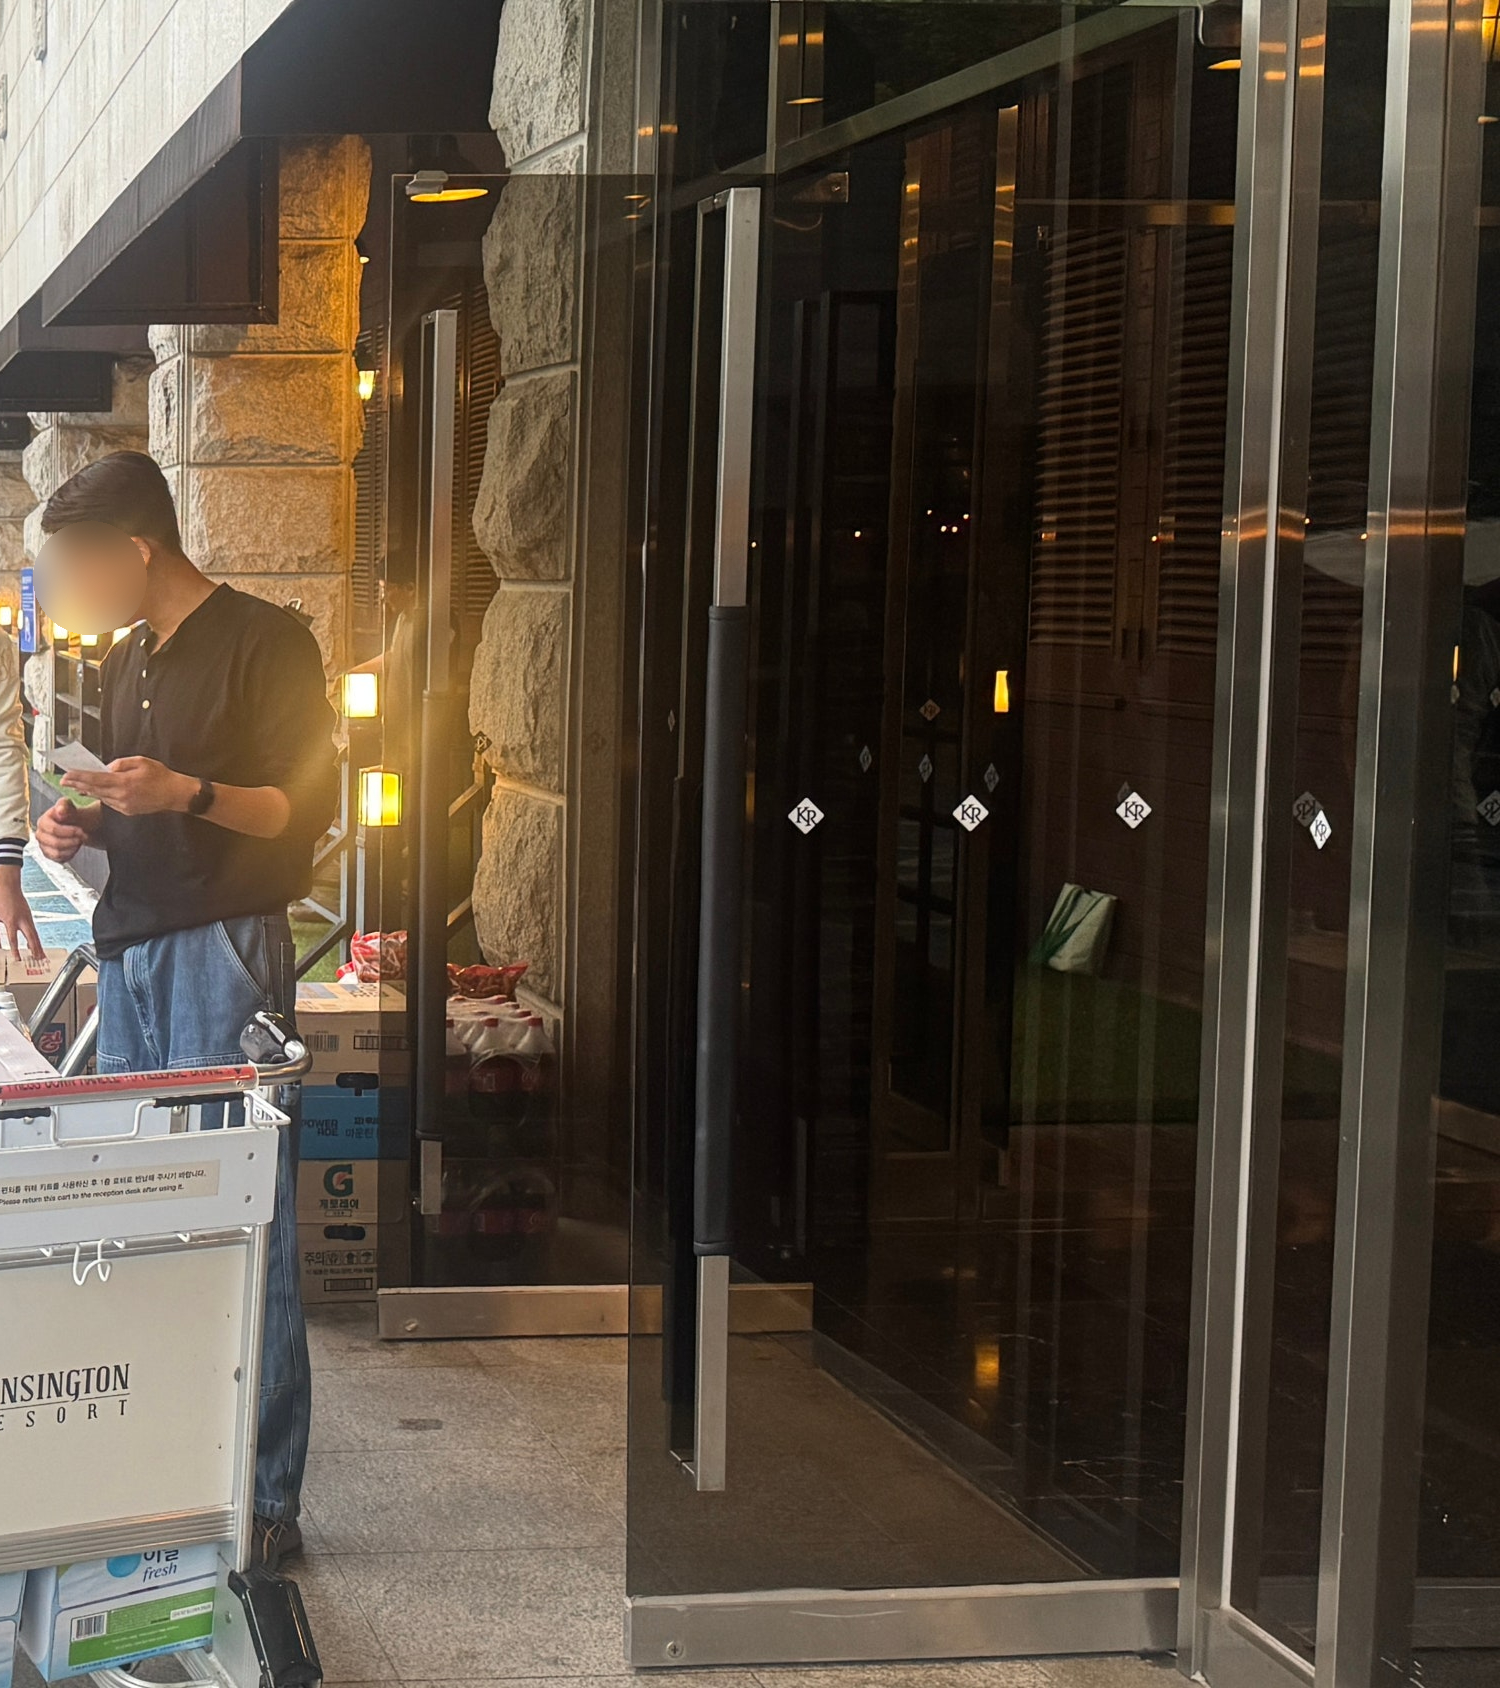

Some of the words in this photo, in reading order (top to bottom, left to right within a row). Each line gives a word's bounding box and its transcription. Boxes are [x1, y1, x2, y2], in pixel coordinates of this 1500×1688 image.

[796, 806, 817, 826] KR
[960, 803, 982, 824] KR
[1124, 801, 1145, 821] KR
[1315, 820, 1327, 841] KR
[324, 1164, 353, 1198] G
[22, 1196, 42, 1204] return
[43, 1194, 55, 1202] this
[57, 1193, 71, 1201] cart
[80, 1191, 91, 1199] the
[93, 1188, 124, 1198] reception
[125, 1187, 141, 1195] desk
[142, 1186, 158, 1194] after
[159, 1184, 176, 1193] using
[319, 1198, 359, 1210] 게토레이
[142, 1562, 177, 1583] fresh
